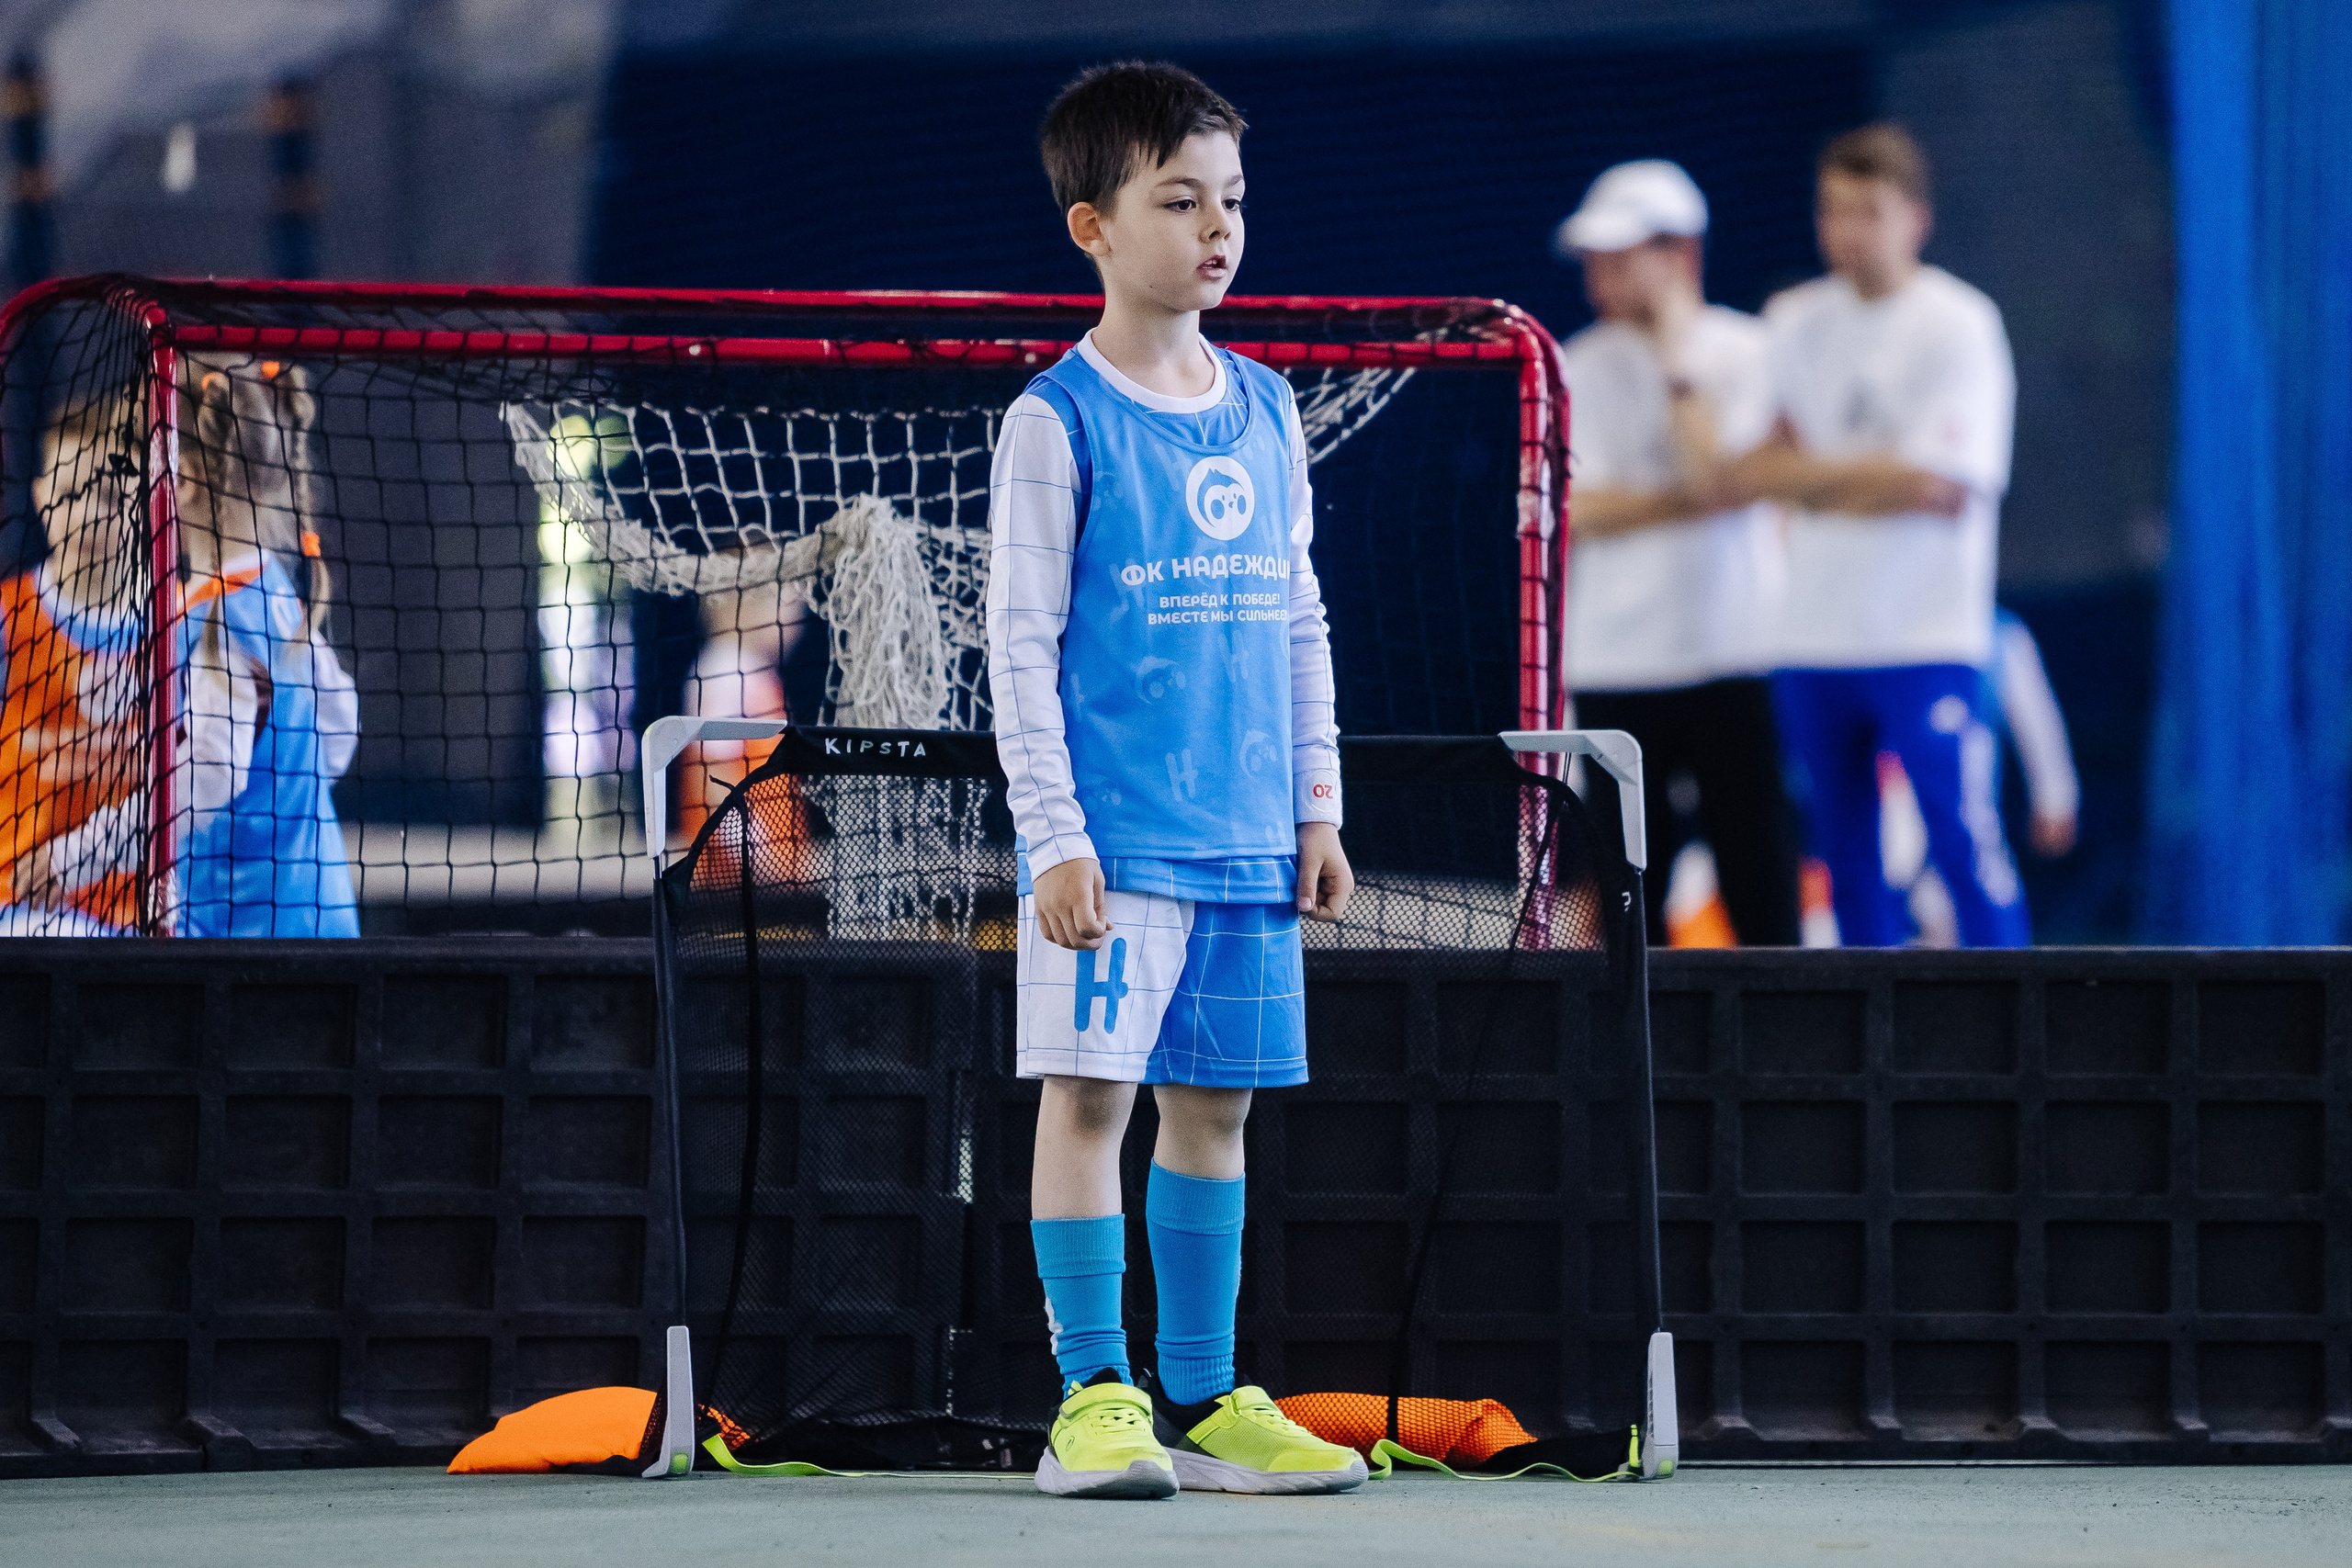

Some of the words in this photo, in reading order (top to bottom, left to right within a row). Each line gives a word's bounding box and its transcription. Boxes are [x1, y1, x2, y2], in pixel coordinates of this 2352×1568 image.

[1120, 560, 1164, 586] ФК
[1159, 592, 1218, 609] ВПЕРЁД
[1220, 594, 1229, 606] К
[1232, 592, 1281, 607] ПОБЕДЕ!
[1148, 610, 1209, 626] ВМЕСТЕ
[1210, 610, 1234, 623] МЫ
[824, 738, 927, 758] KIPSTA
[1312, 784, 1334, 799] 20
